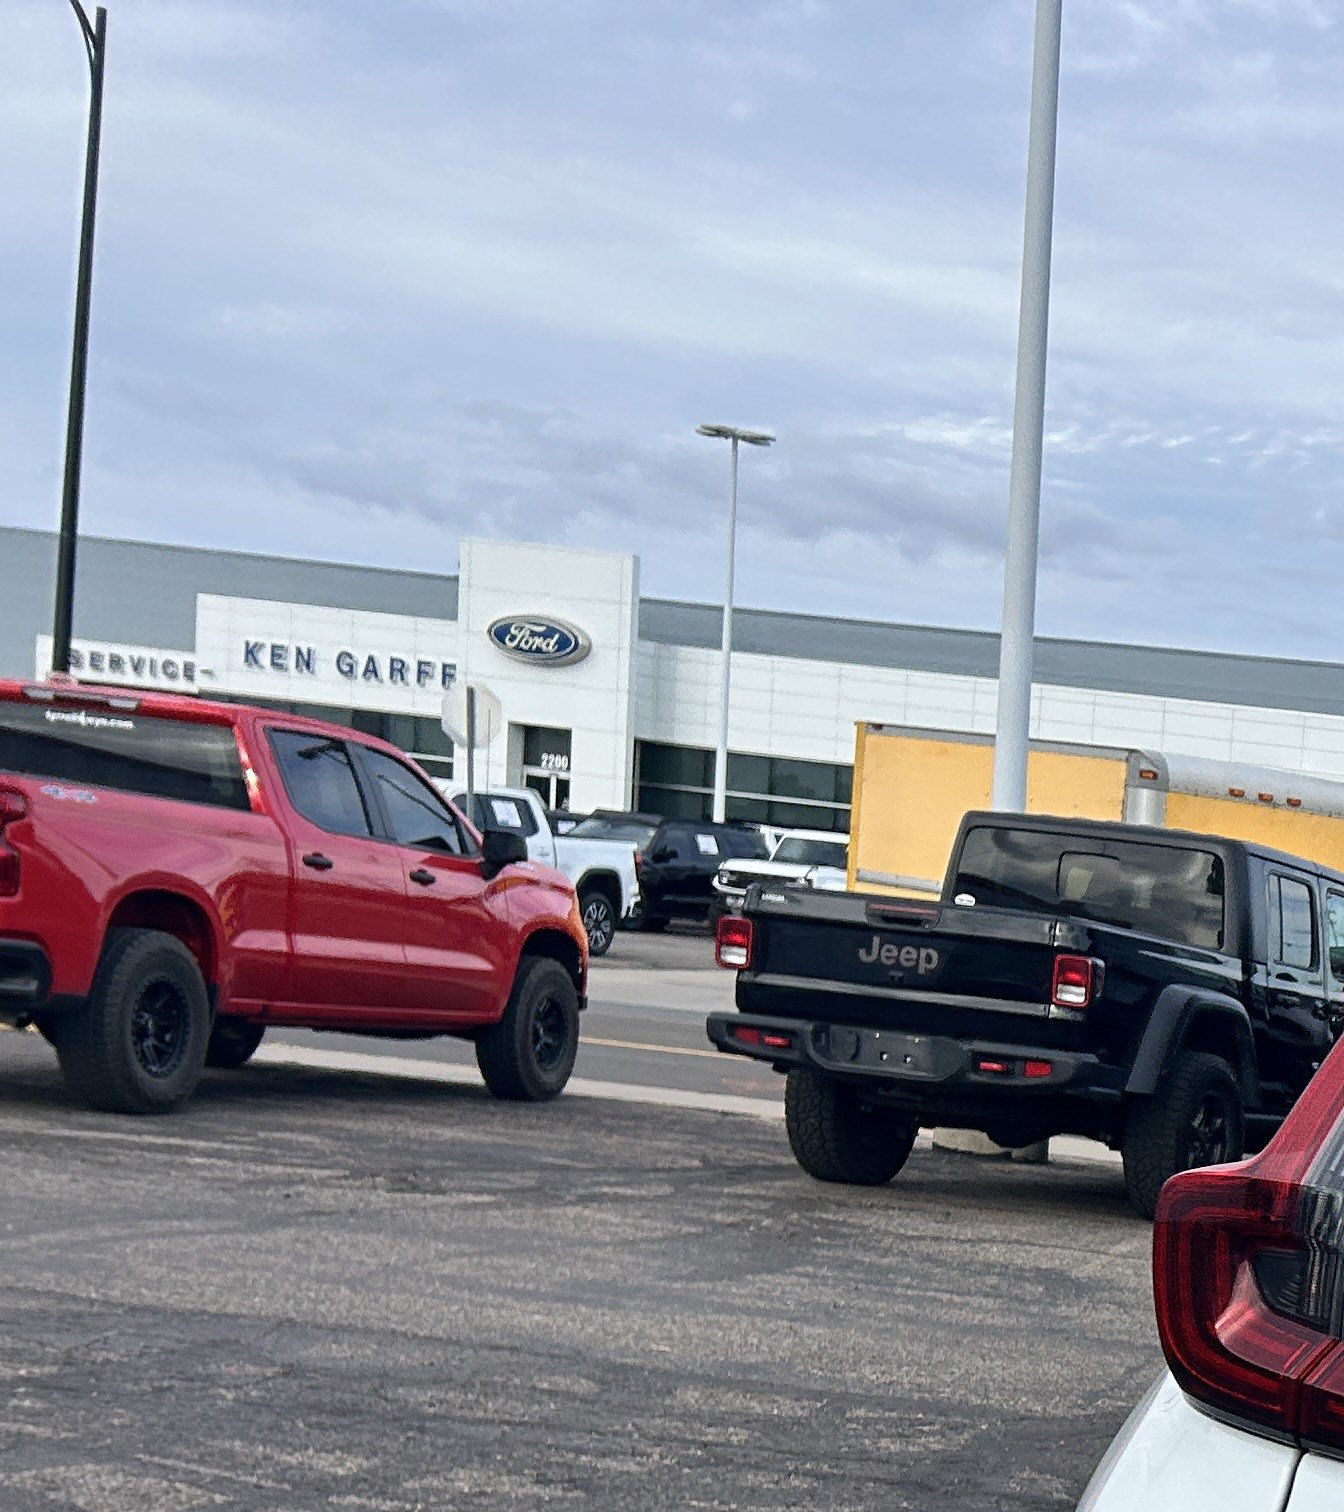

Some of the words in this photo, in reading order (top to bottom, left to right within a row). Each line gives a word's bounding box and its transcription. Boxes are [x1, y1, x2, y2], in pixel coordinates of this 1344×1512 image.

[504, 622, 559, 653] Ford
[70, 649, 196, 682] SERVICE
[244, 640, 314, 674] KEN
[336, 650, 458, 688] GARFF
[858, 936, 940, 975] Jeep
